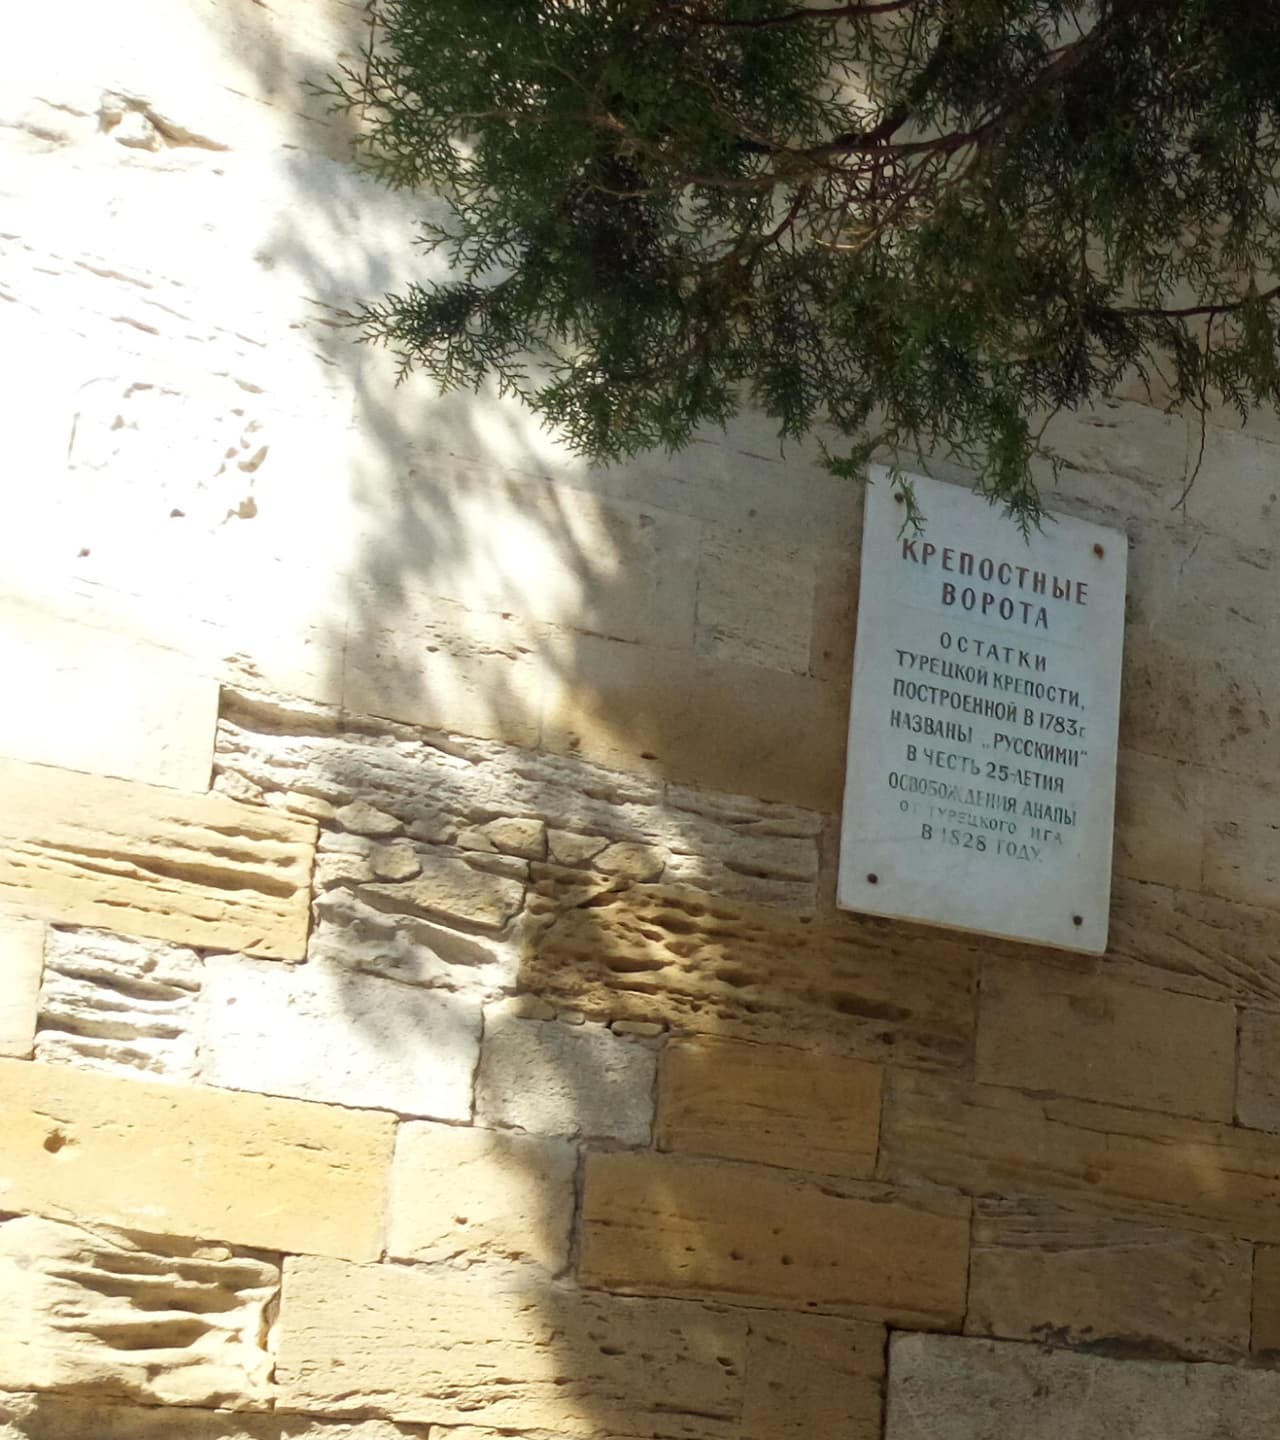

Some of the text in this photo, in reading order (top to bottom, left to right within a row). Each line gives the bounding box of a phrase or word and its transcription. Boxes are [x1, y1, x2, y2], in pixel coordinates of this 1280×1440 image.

[901, 537, 1089, 606] КРЕПОСТНЫЕ
[941, 581, 1049, 630] ВОРОТА
[939, 631, 1048, 673] ОСТАТКИ
[892, 677, 1017, 724] ПОСТРОЕННОЙ
[1023, 705, 1035, 727] В
[895, 648, 1086, 712] ТУРЕЦКОЙ КРЕПОСТИ,
[890, 708, 974, 744] НАЗВАНЫ
[906, 743, 1065, 794] В ЧЕСТЬ 25-ЛЕТИЯ
[888, 770, 1078, 827] ОСВОБОЖДЕНИЯ АНАПЫ
[921, 822, 934, 841] В
[941, 825, 987, 853] 1828
